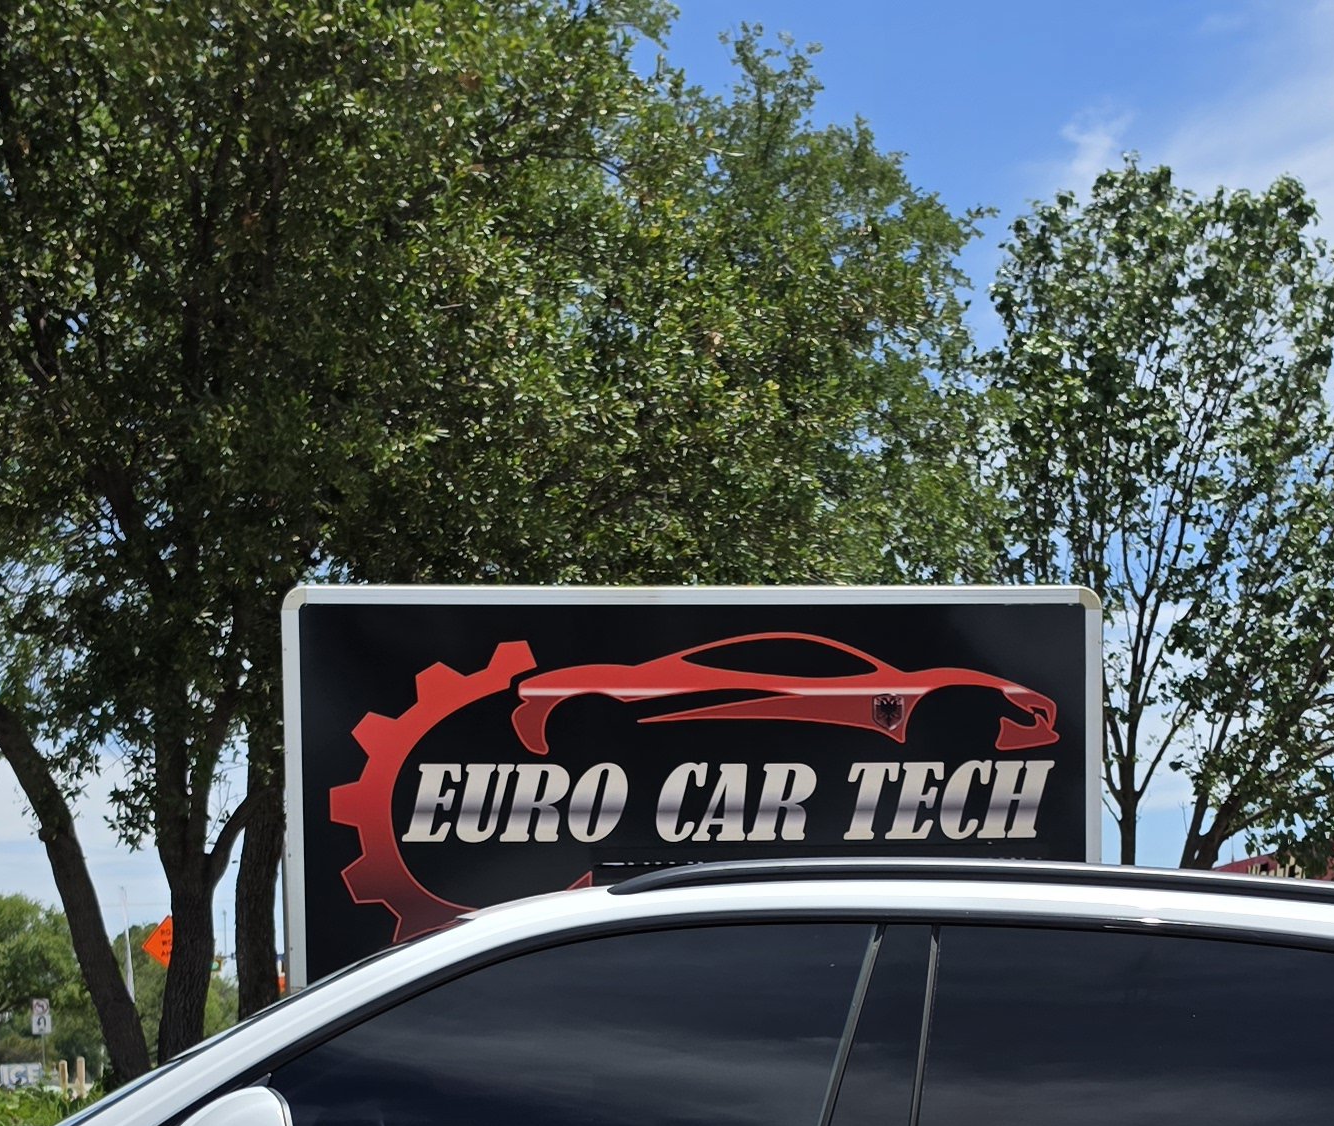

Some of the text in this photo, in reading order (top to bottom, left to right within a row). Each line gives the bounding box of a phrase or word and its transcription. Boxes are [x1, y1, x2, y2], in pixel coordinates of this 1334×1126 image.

[402, 760, 1055, 843] EURO CAR TECH
